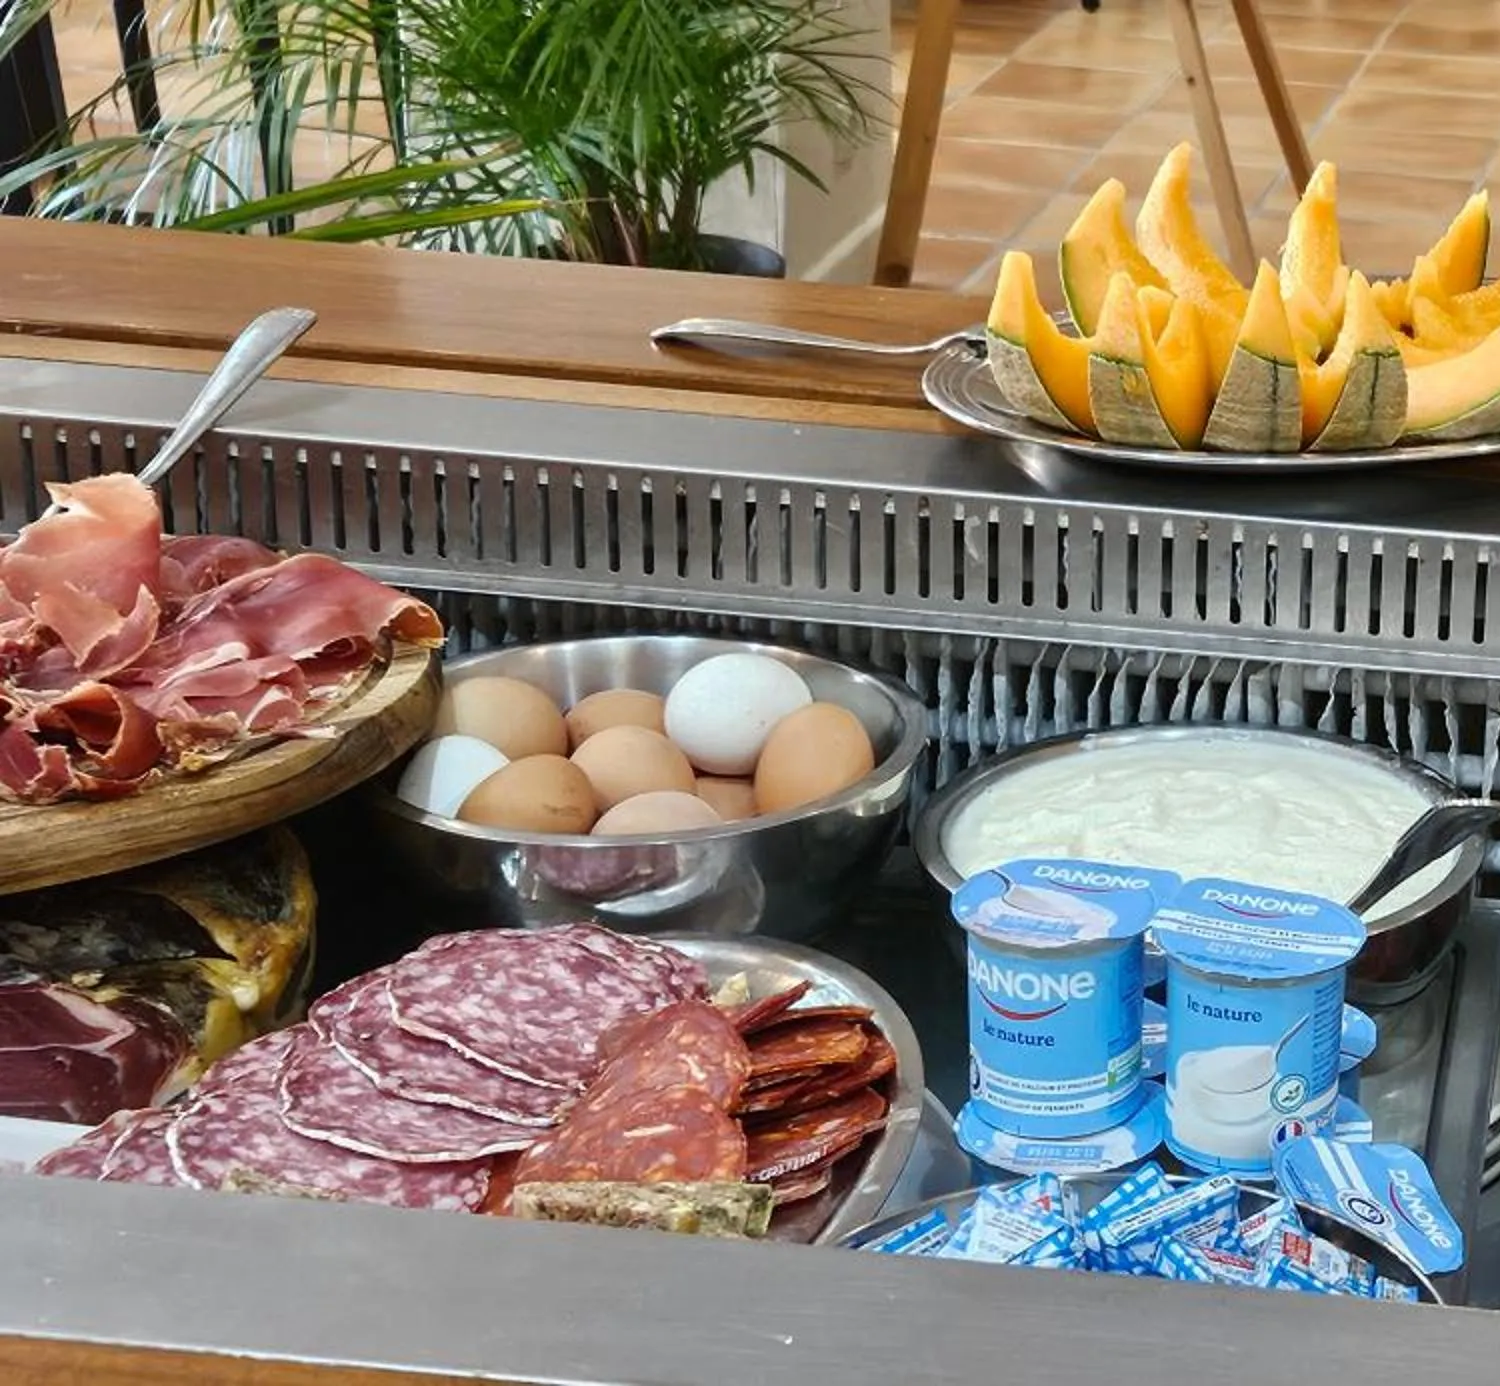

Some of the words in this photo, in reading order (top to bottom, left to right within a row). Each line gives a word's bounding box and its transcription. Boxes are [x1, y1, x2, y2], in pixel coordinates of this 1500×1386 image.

[1202, 889, 1321, 916] DANONE
[967, 953, 1095, 1001] DANONE
[1187, 994, 1200, 1013] le
[1202, 1004, 1262, 1023] nature
[983, 1018, 995, 1033] le
[997, 1026, 1055, 1047] nature
[1387, 1167, 1452, 1248] DANONE
